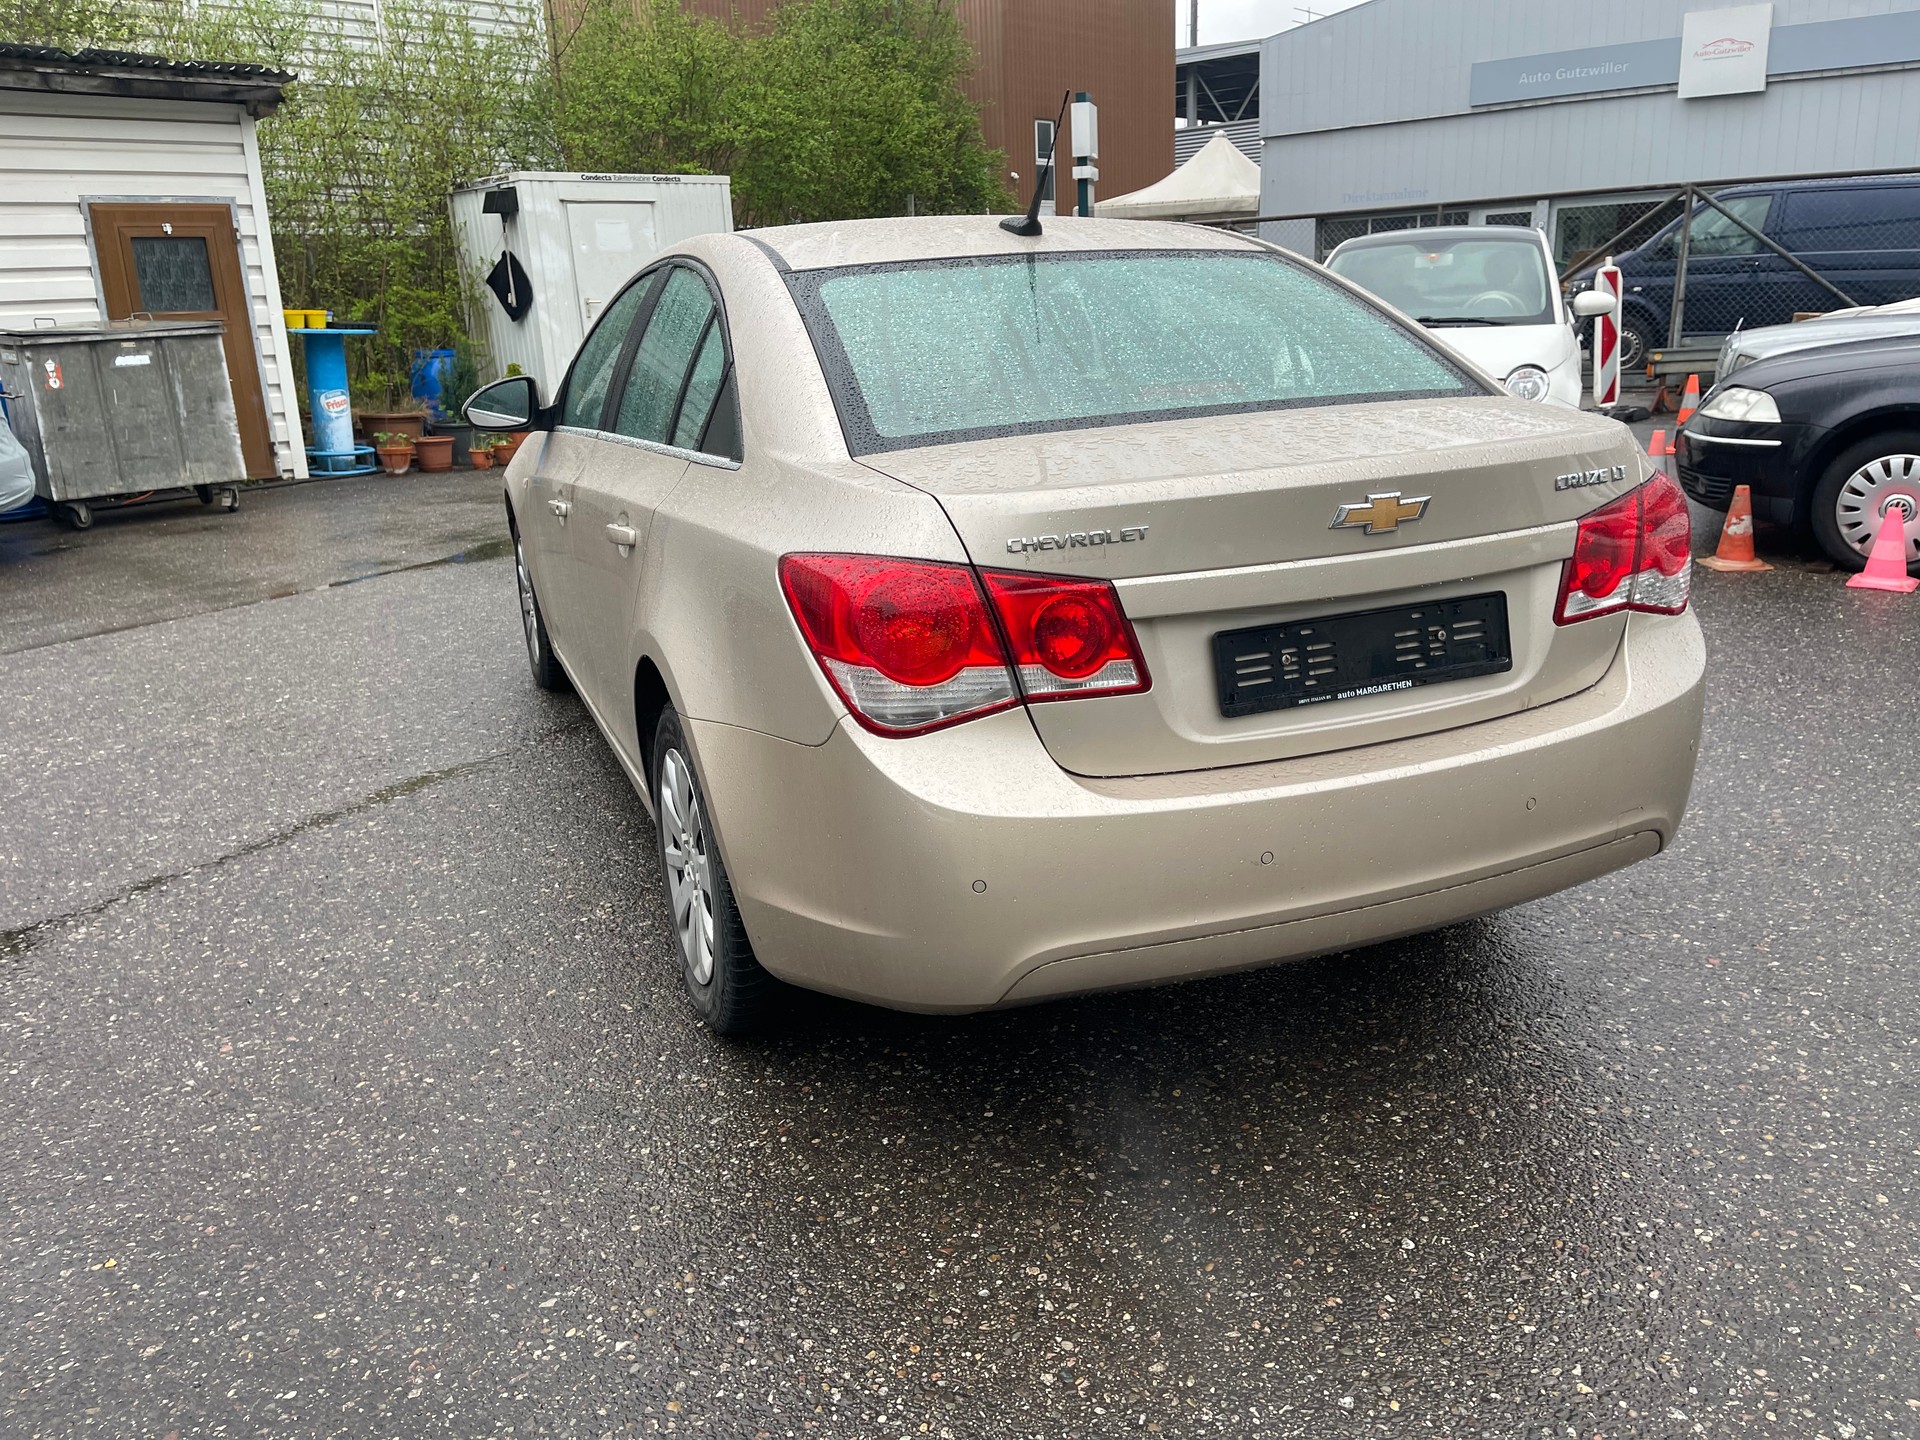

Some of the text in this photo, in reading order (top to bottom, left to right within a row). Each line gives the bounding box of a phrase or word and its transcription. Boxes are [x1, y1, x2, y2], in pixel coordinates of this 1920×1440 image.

[1519, 62, 1630, 84] Auto Gutzwiller
[581, 174, 612, 182] Condecta
[652, 175, 681, 183] Condecta
[1555, 465, 1627, 492] CRUZE LT
[1006, 525, 1150, 554] CHEVROLET
[1337, 691, 1355, 700] auto
[1356, 680, 1413, 696] MARGARETHEN
